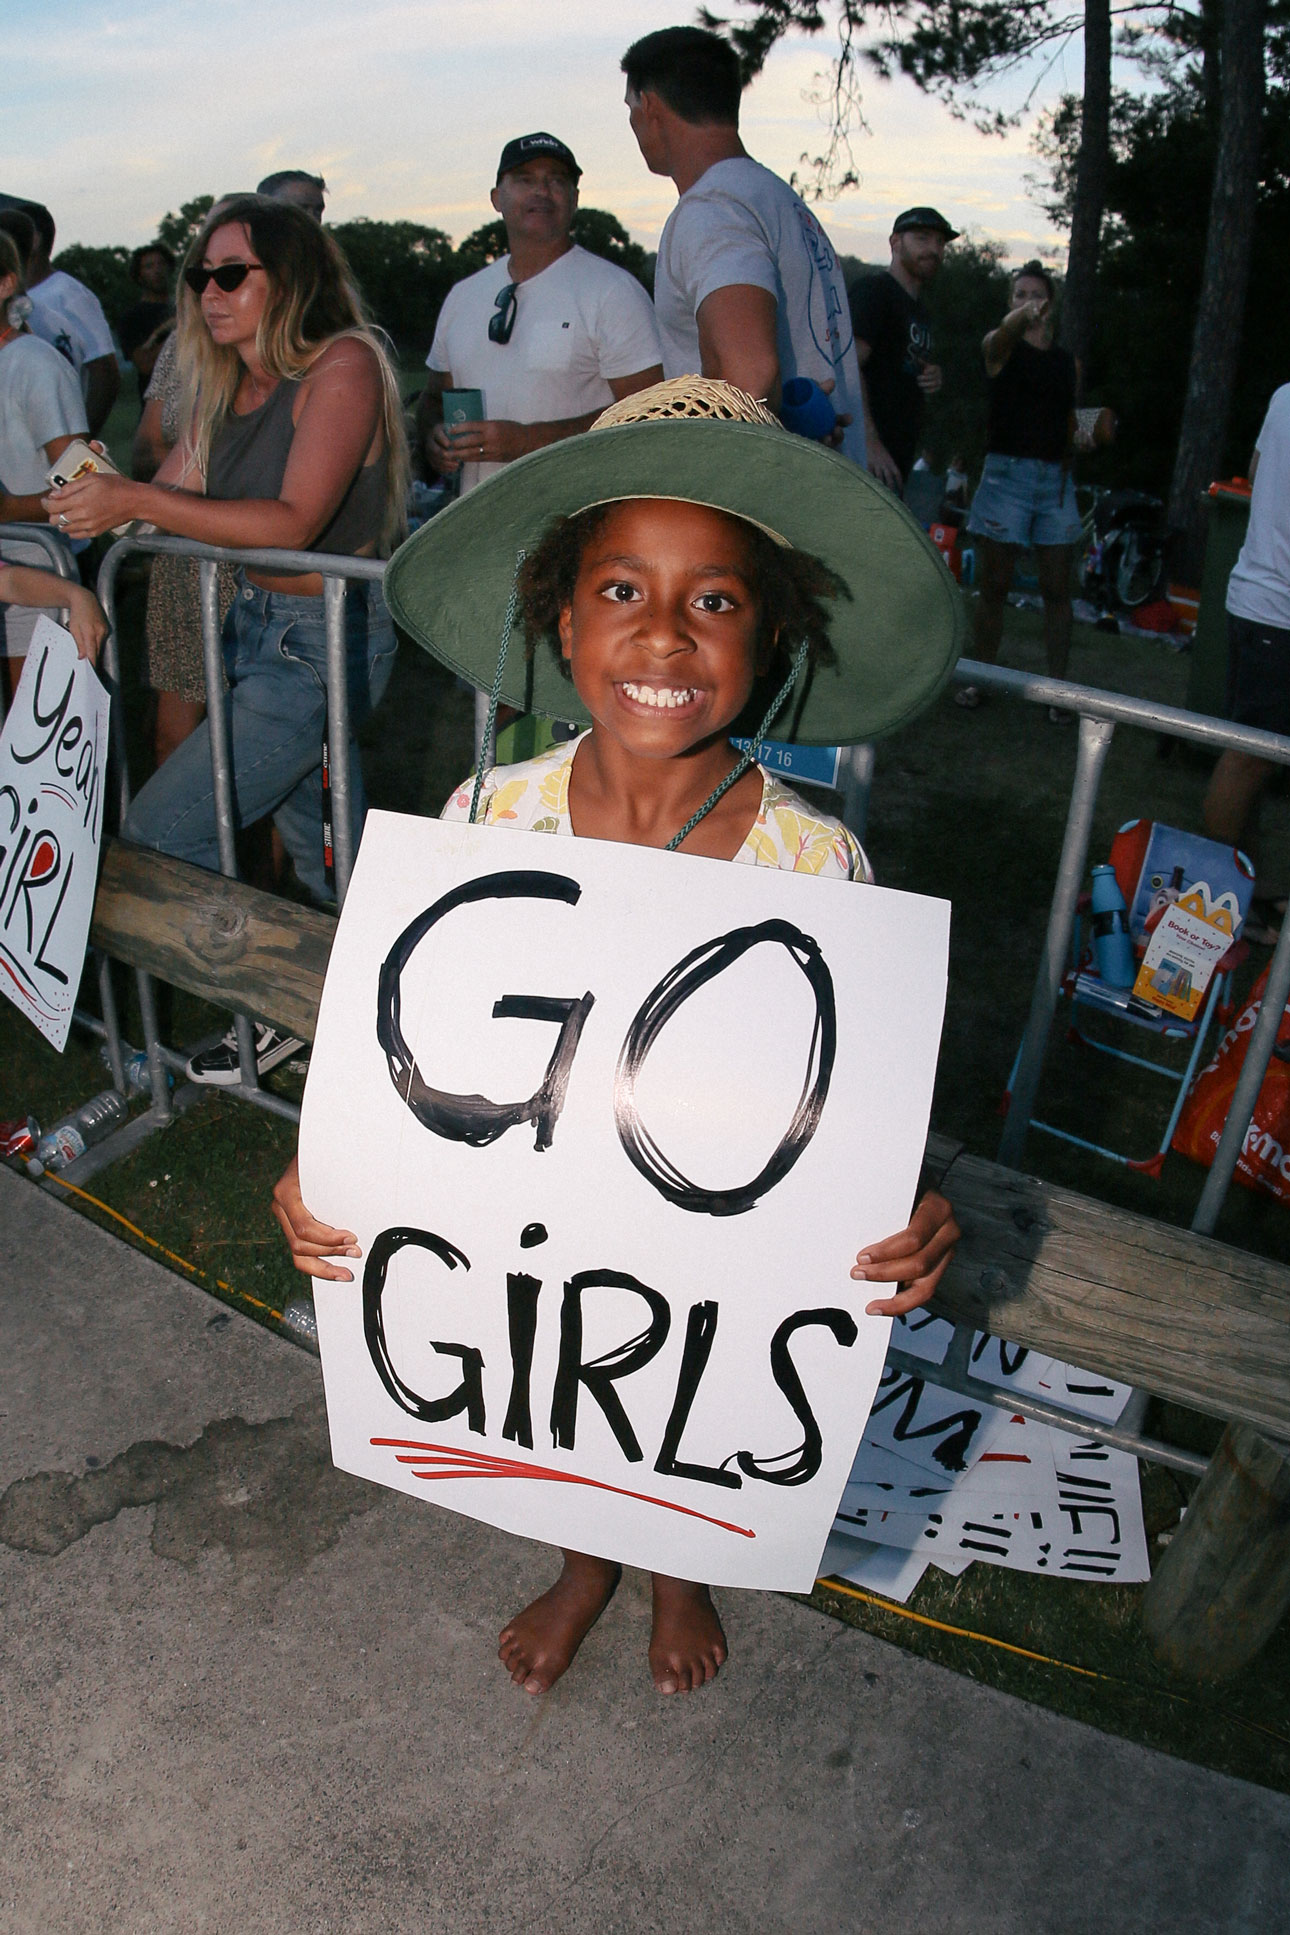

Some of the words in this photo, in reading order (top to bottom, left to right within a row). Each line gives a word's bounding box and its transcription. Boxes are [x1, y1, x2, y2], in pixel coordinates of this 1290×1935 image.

[758, 744, 772, 761] 17
[776, 750, 792, 767] 16
[1168, 920, 1189, 936] Book
[1202, 938, 1221, 951] Toy?
[377, 870, 837, 1215] GO
